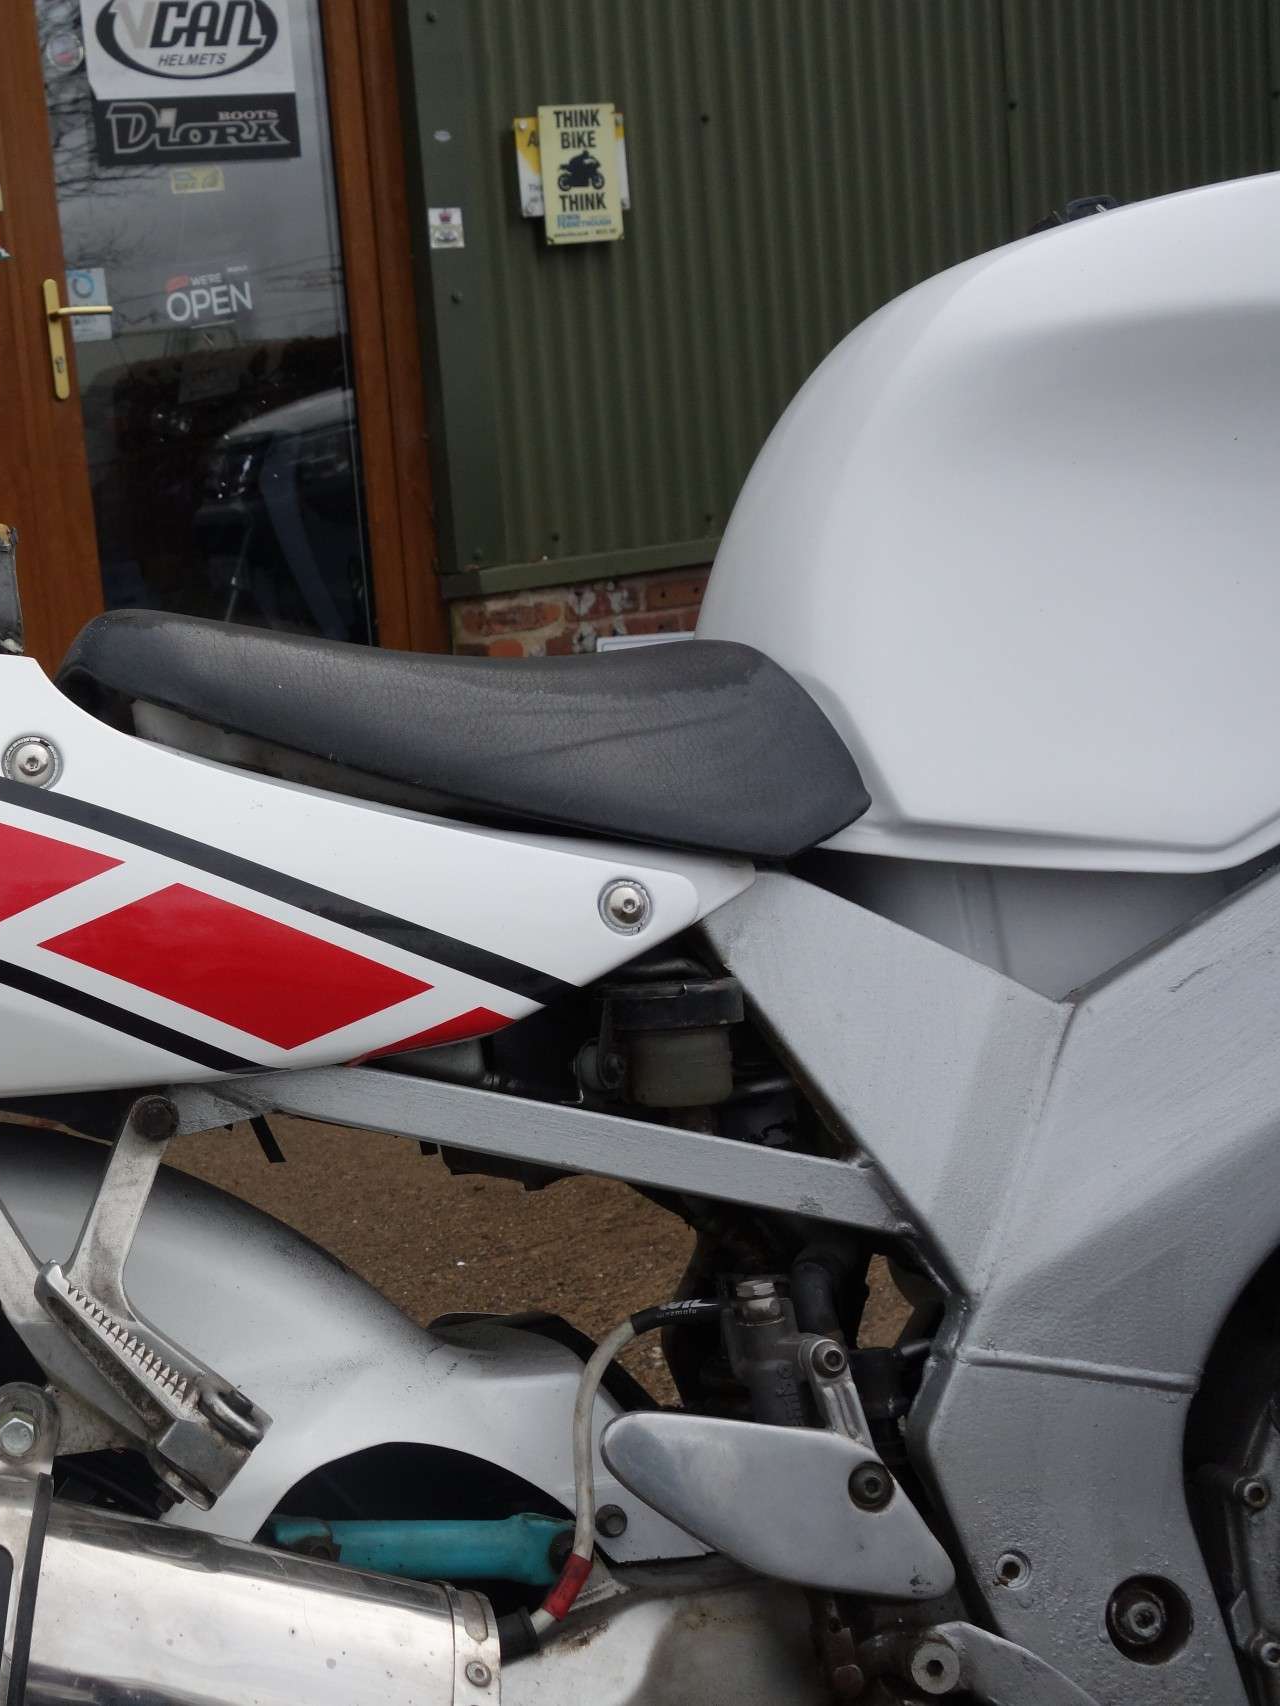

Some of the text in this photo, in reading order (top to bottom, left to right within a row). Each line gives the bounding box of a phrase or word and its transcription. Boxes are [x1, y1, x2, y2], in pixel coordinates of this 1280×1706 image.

[158, 52, 227, 67] HELMETS
[218, 109, 279, 121] BOOTS
[553, 109, 601, 128] THINK
[560, 131, 596, 149] BIKE
[559, 193, 607, 212] THINK
[166, 281, 254, 322] OPEN
